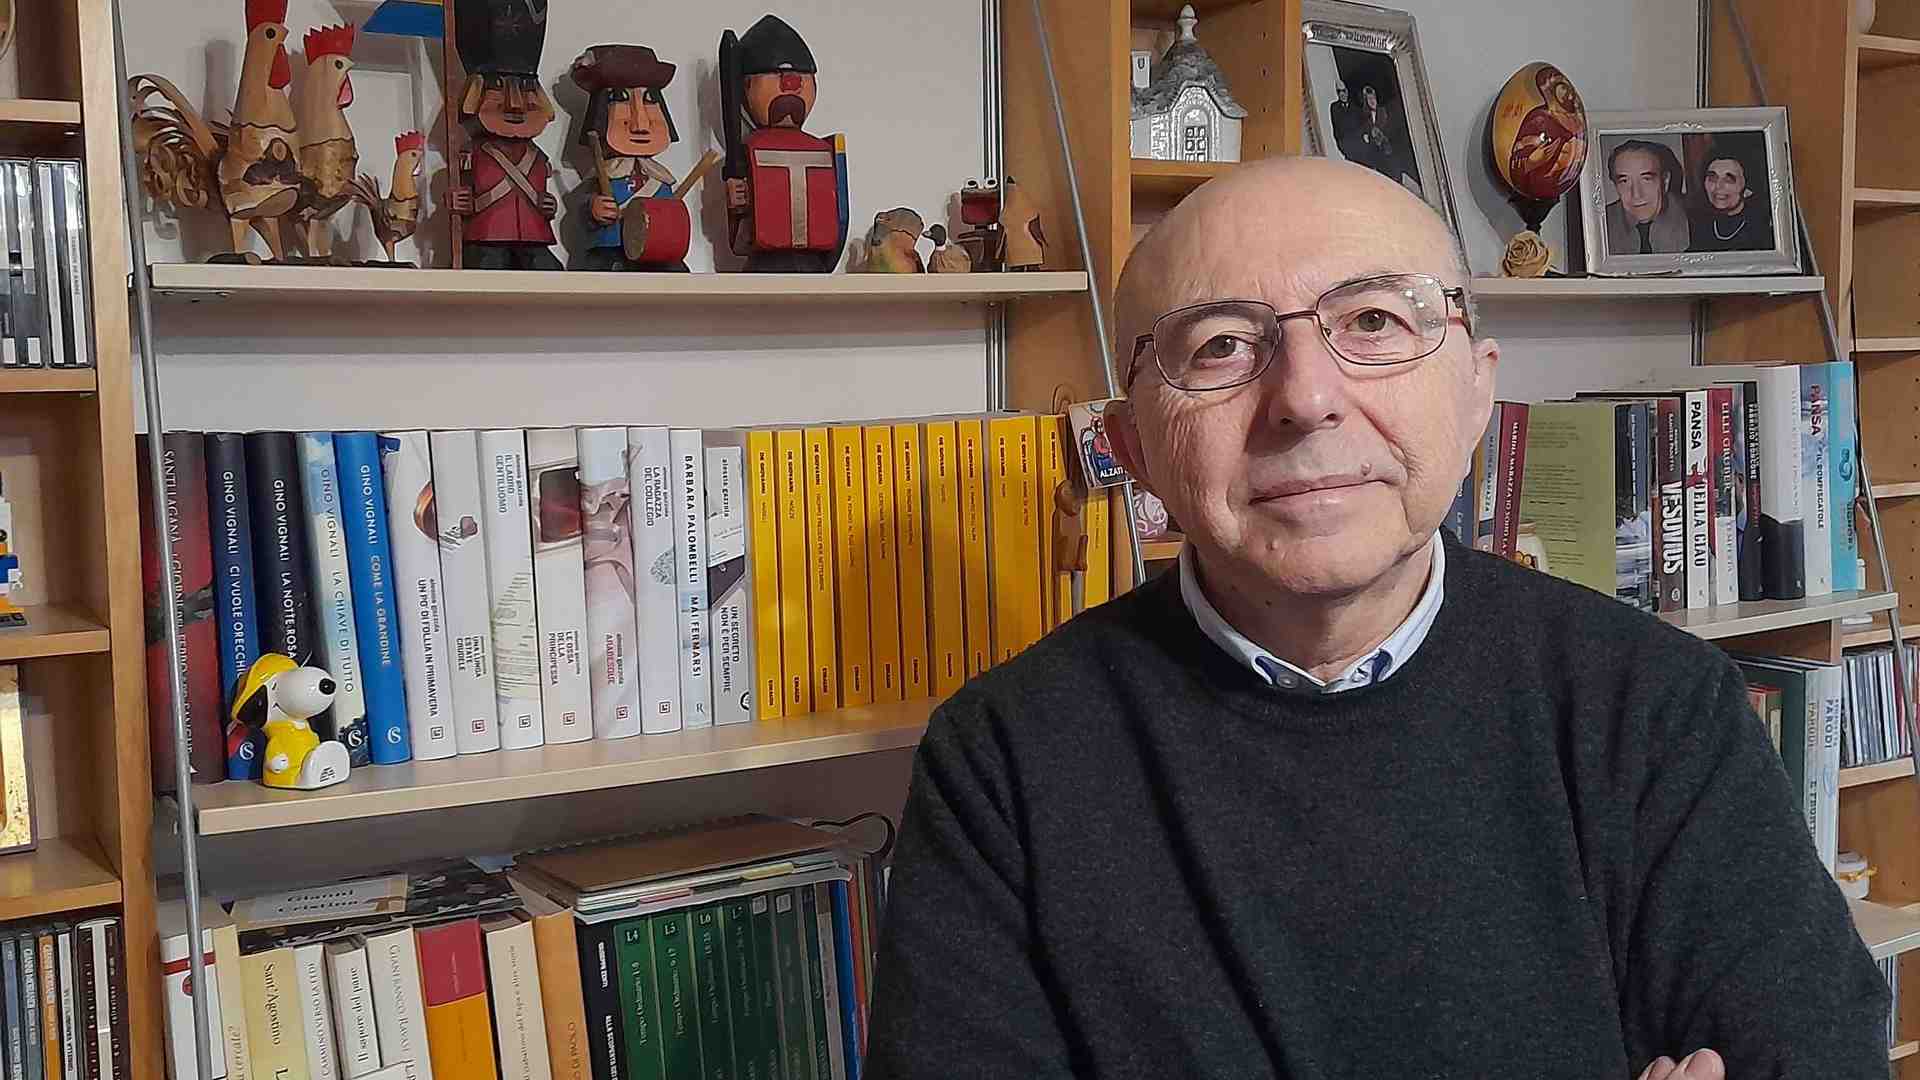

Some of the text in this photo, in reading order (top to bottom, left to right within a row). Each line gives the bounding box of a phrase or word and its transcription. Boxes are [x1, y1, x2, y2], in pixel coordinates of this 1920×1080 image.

[1691, 401, 1702, 450] PANSA
[1811, 385, 1821, 435] PANSA
[1509, 422, 1519, 456] MARINA
[222, 471, 236, 505] GINO
[496, 455, 507, 513] GENTILUOMO
[1505, 458, 1516, 498] MARAZZA
[1723, 438, 1731, 492] GRUBER
[644, 468, 654, 527] DEL COLLEGIO
[653, 467, 663, 519] LA RAGAZZA
[225, 507, 239, 554] VIGNALI
[685, 456, 697, 584] BARBARA PALOMBELLI
[1662, 481, 1683, 575] VESUVIUS
[229, 565, 241, 578] CI
[273, 479, 298, 659] GINO VIGNALI LA NOTTE ROSA
[359, 465, 392, 667] GINO VIGNALI COME LA GRANDINE
[1695, 534, 1706, 567] CIAO
[230, 581, 243, 617] VUOLE
[320, 469, 354, 693] GINO VIGNALI LA CHIAVE DI TUTTO
[417, 579, 427, 593] UN
[420, 611, 430, 620] DI
[421, 621, 433, 652] FOLLIA
[690, 597, 701, 678] MAI FERMARSI
[720, 607, 729, 625] NON
[730, 606, 740, 662] UN SEGRETO
[424, 654, 434, 663] IN
[456, 638, 466, 671] CRUDELE
[465, 637, 473, 664] ESTATE
[473, 636, 483, 678] UNA LUNGA
[548, 633, 558, 686] PRINCIPESSA
[557, 633, 565, 658] DELLA
[566, 632, 574, 664] LE OSSA
[606, 634, 616, 685] ARABESQUE
[721, 636, 730, 654] PER
[425, 665, 439, 716] PRIMAVERA
[722, 656, 731, 693] SEMPRE
[1824, 699, 1833, 749] PARODI
[262, 964, 282, 1045] Sant'Agostino
[350, 967, 369, 1062] Il sapore del pane
[605, 1016, 614, 1032] ALLA
